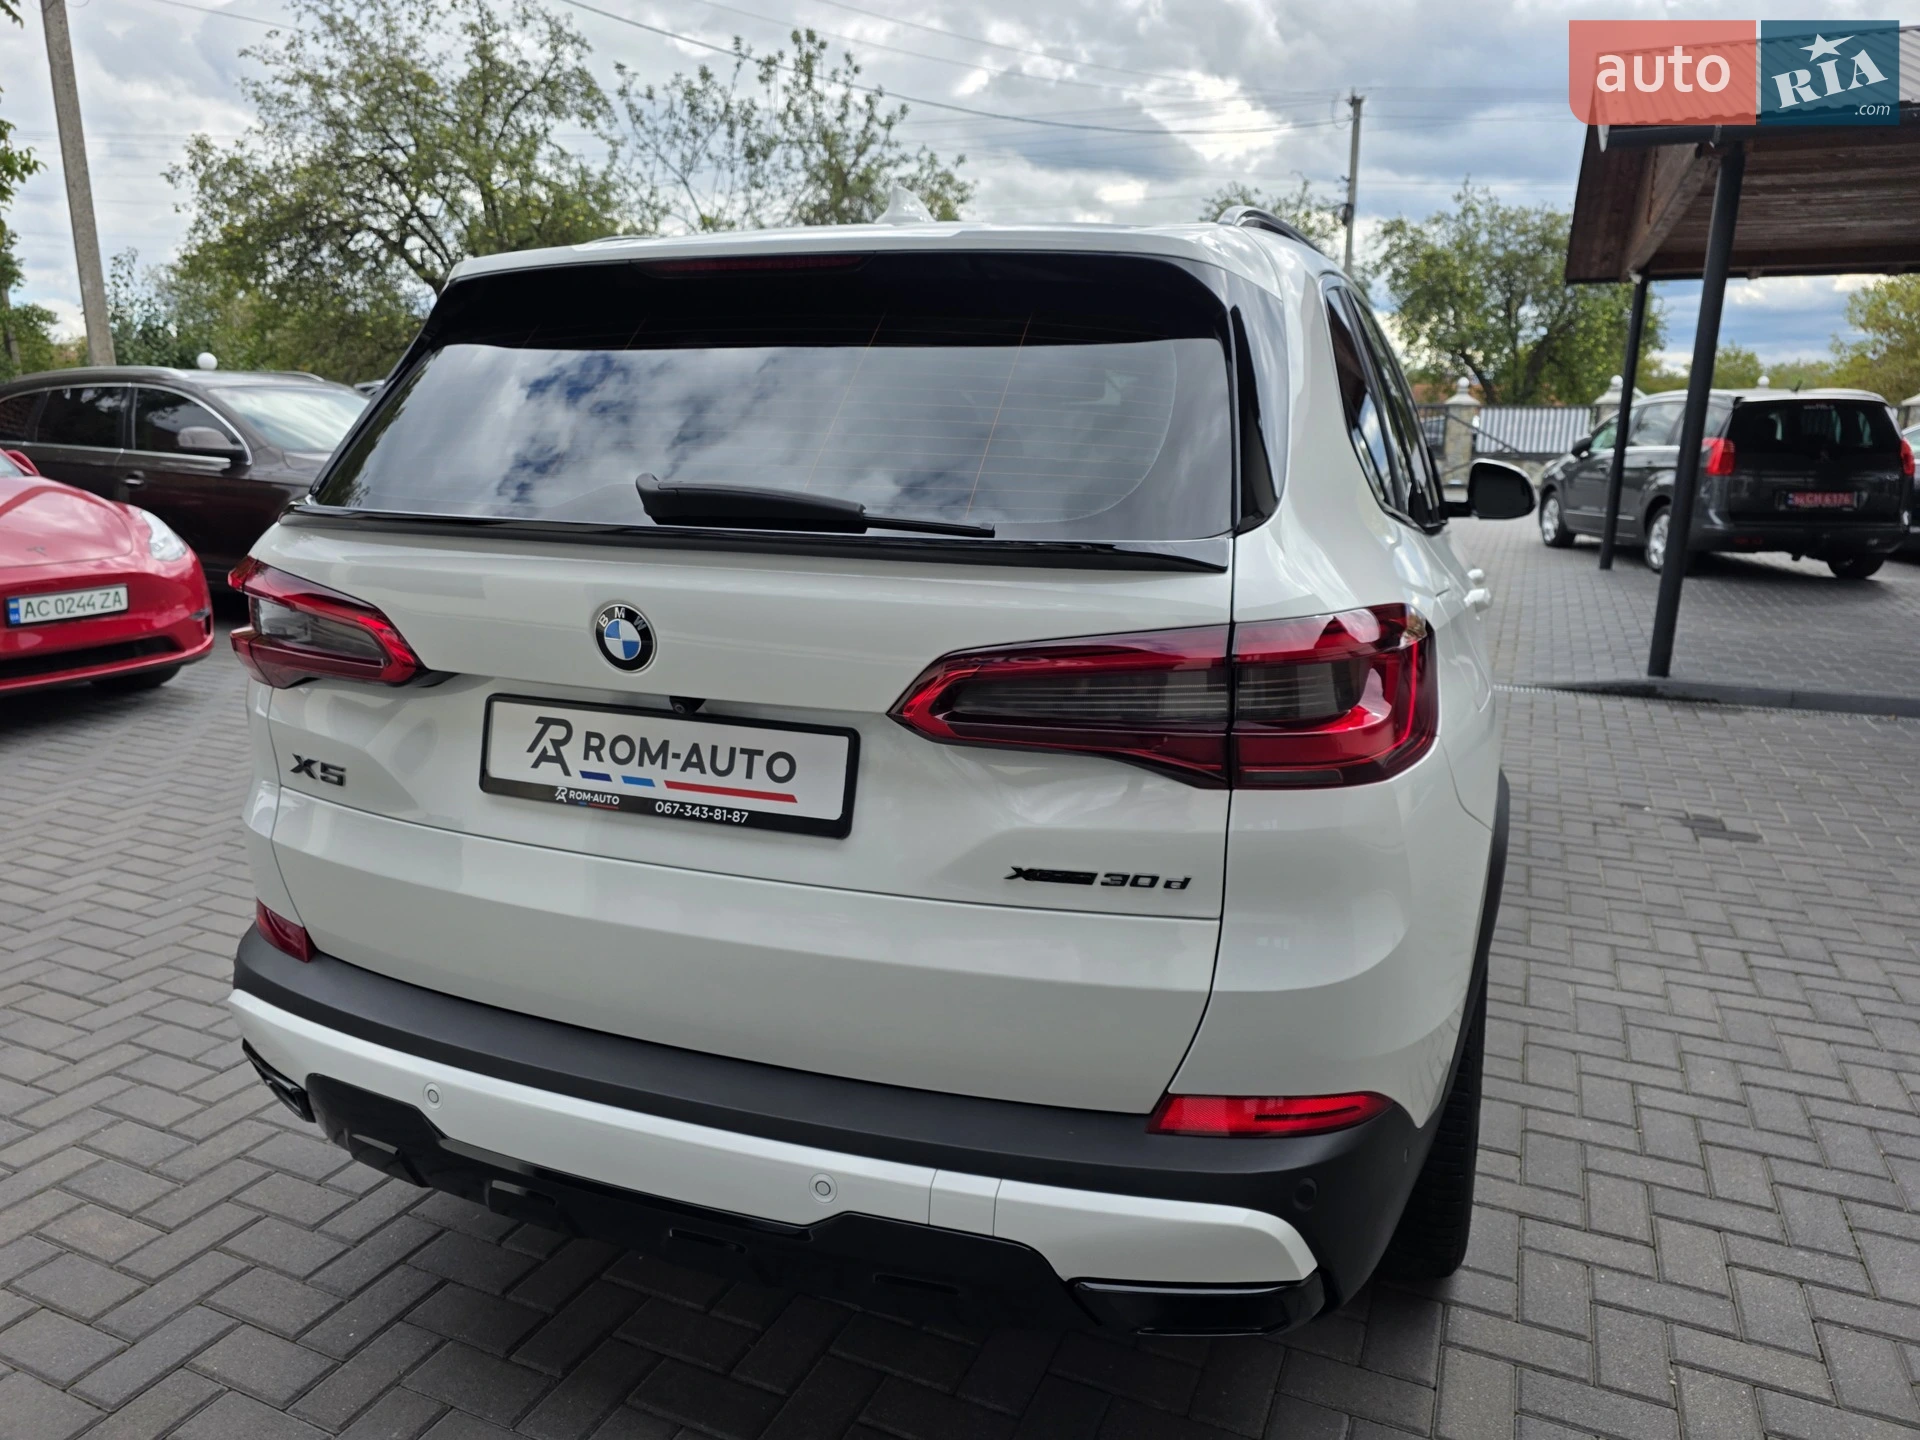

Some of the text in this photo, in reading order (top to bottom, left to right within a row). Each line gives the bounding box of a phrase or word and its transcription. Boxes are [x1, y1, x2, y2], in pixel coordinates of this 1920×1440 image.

[24, 591, 123, 618] AC 0244 ZA
[598, 606, 647, 631] BMW
[290, 753, 347, 787] X5
[582, 730, 797, 784] ROM-AUTO
[568, 790, 620, 805] ROM-AUTO
[655, 801, 749, 824] 067-343-81-87
